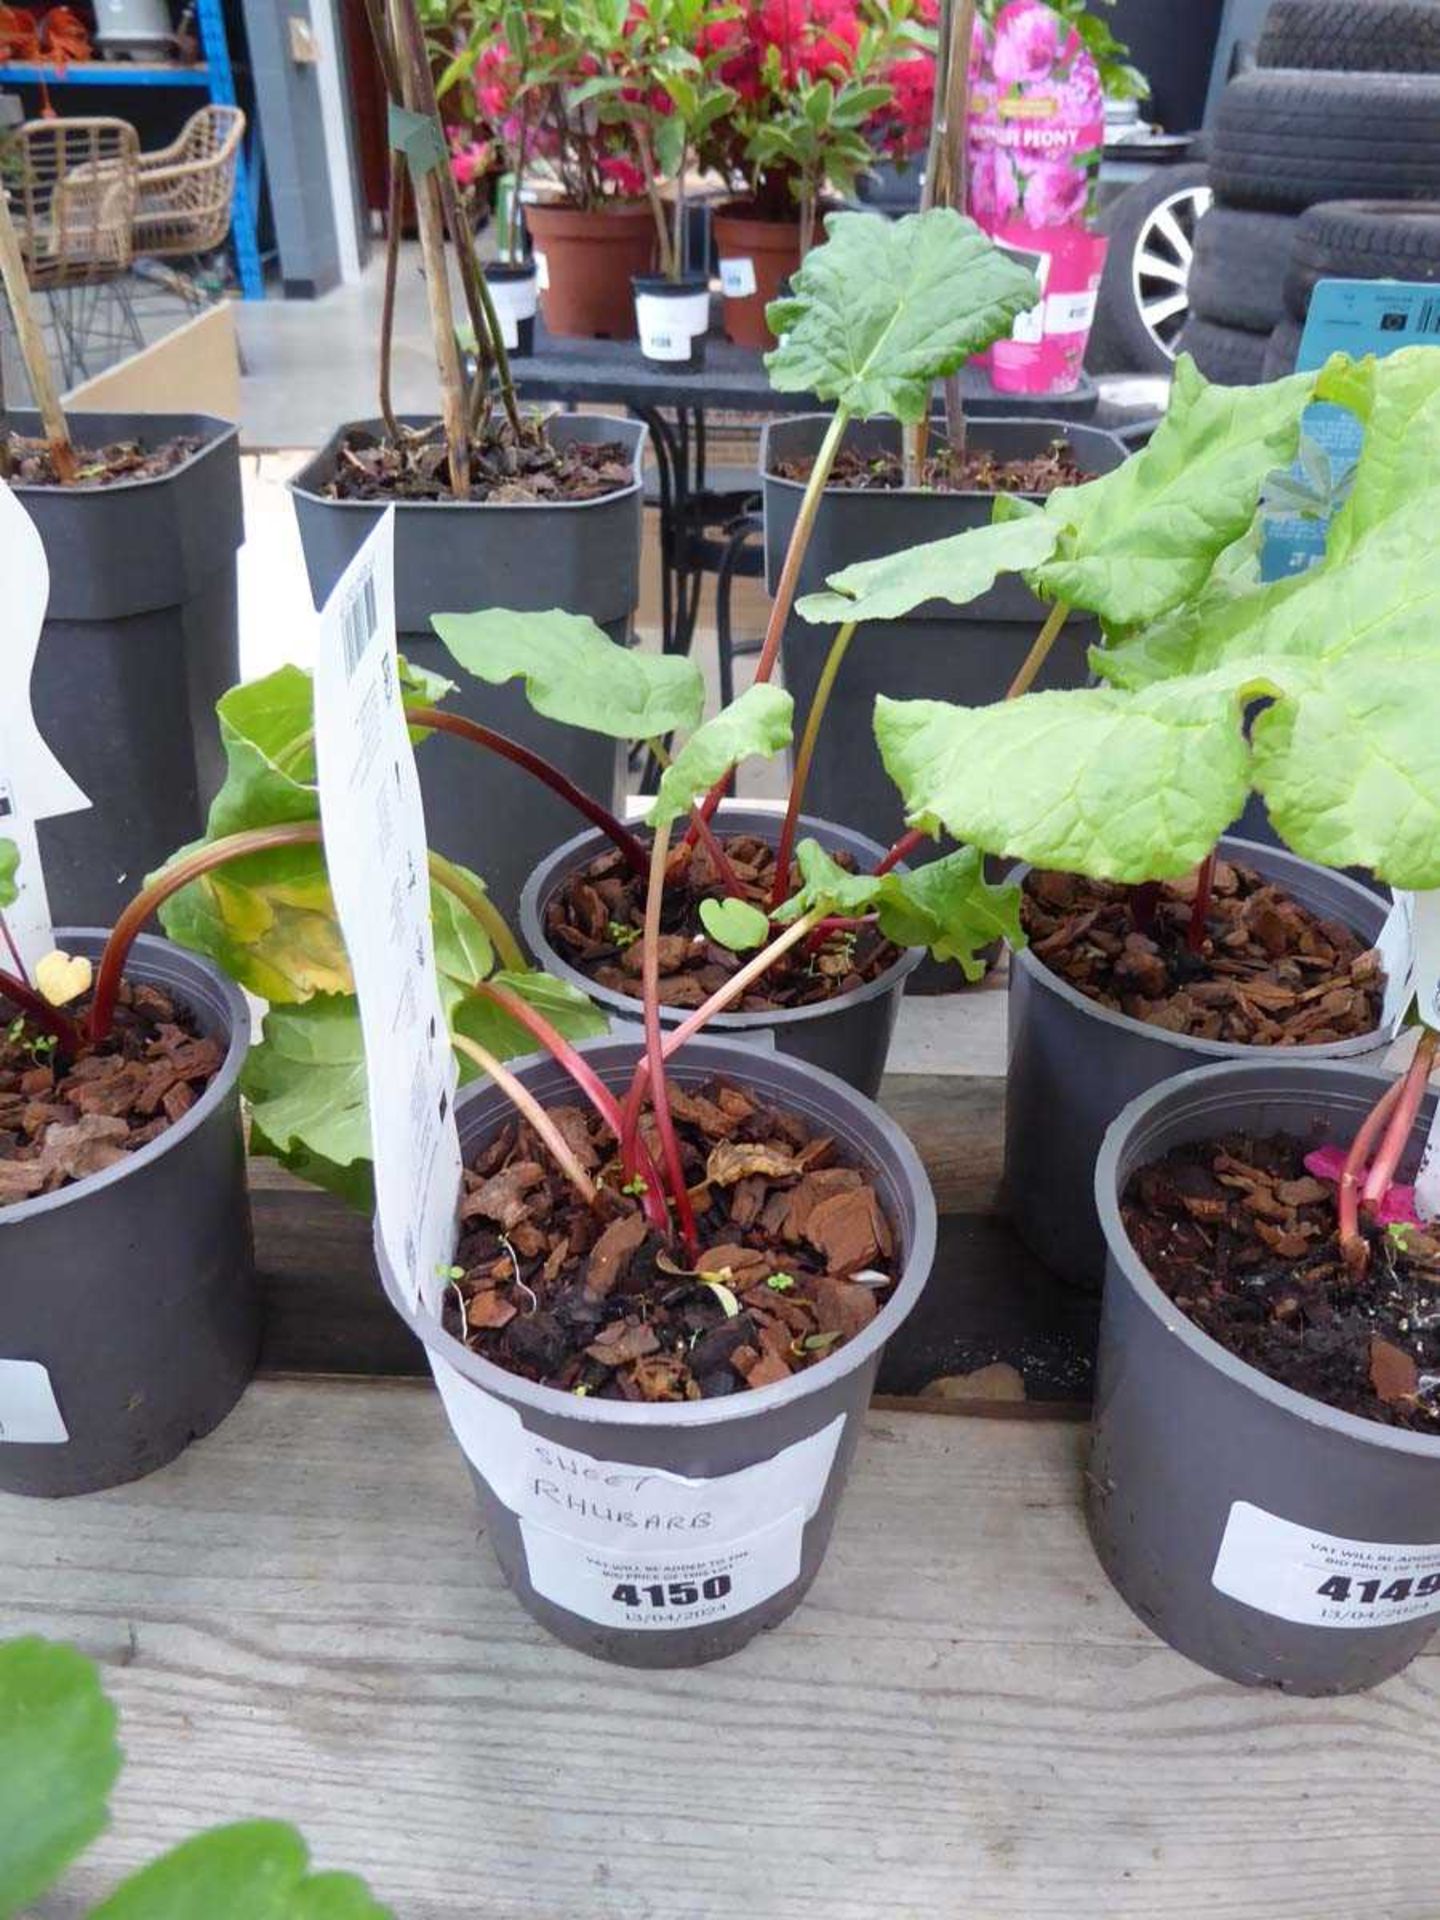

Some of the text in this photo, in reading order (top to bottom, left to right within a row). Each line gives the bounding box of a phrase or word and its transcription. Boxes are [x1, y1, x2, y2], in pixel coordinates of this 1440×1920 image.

[534, 1479, 713, 1529] RHUBARB
[612, 1563, 639, 1572] WILL
[663, 1560, 706, 1572] ADDED
[1310, 1542, 1337, 1555] VAT
[1341, 1549, 1374, 1561] WILL
[611, 1574, 732, 1608] 4150
[1317, 1572, 1440, 1604] 4149
